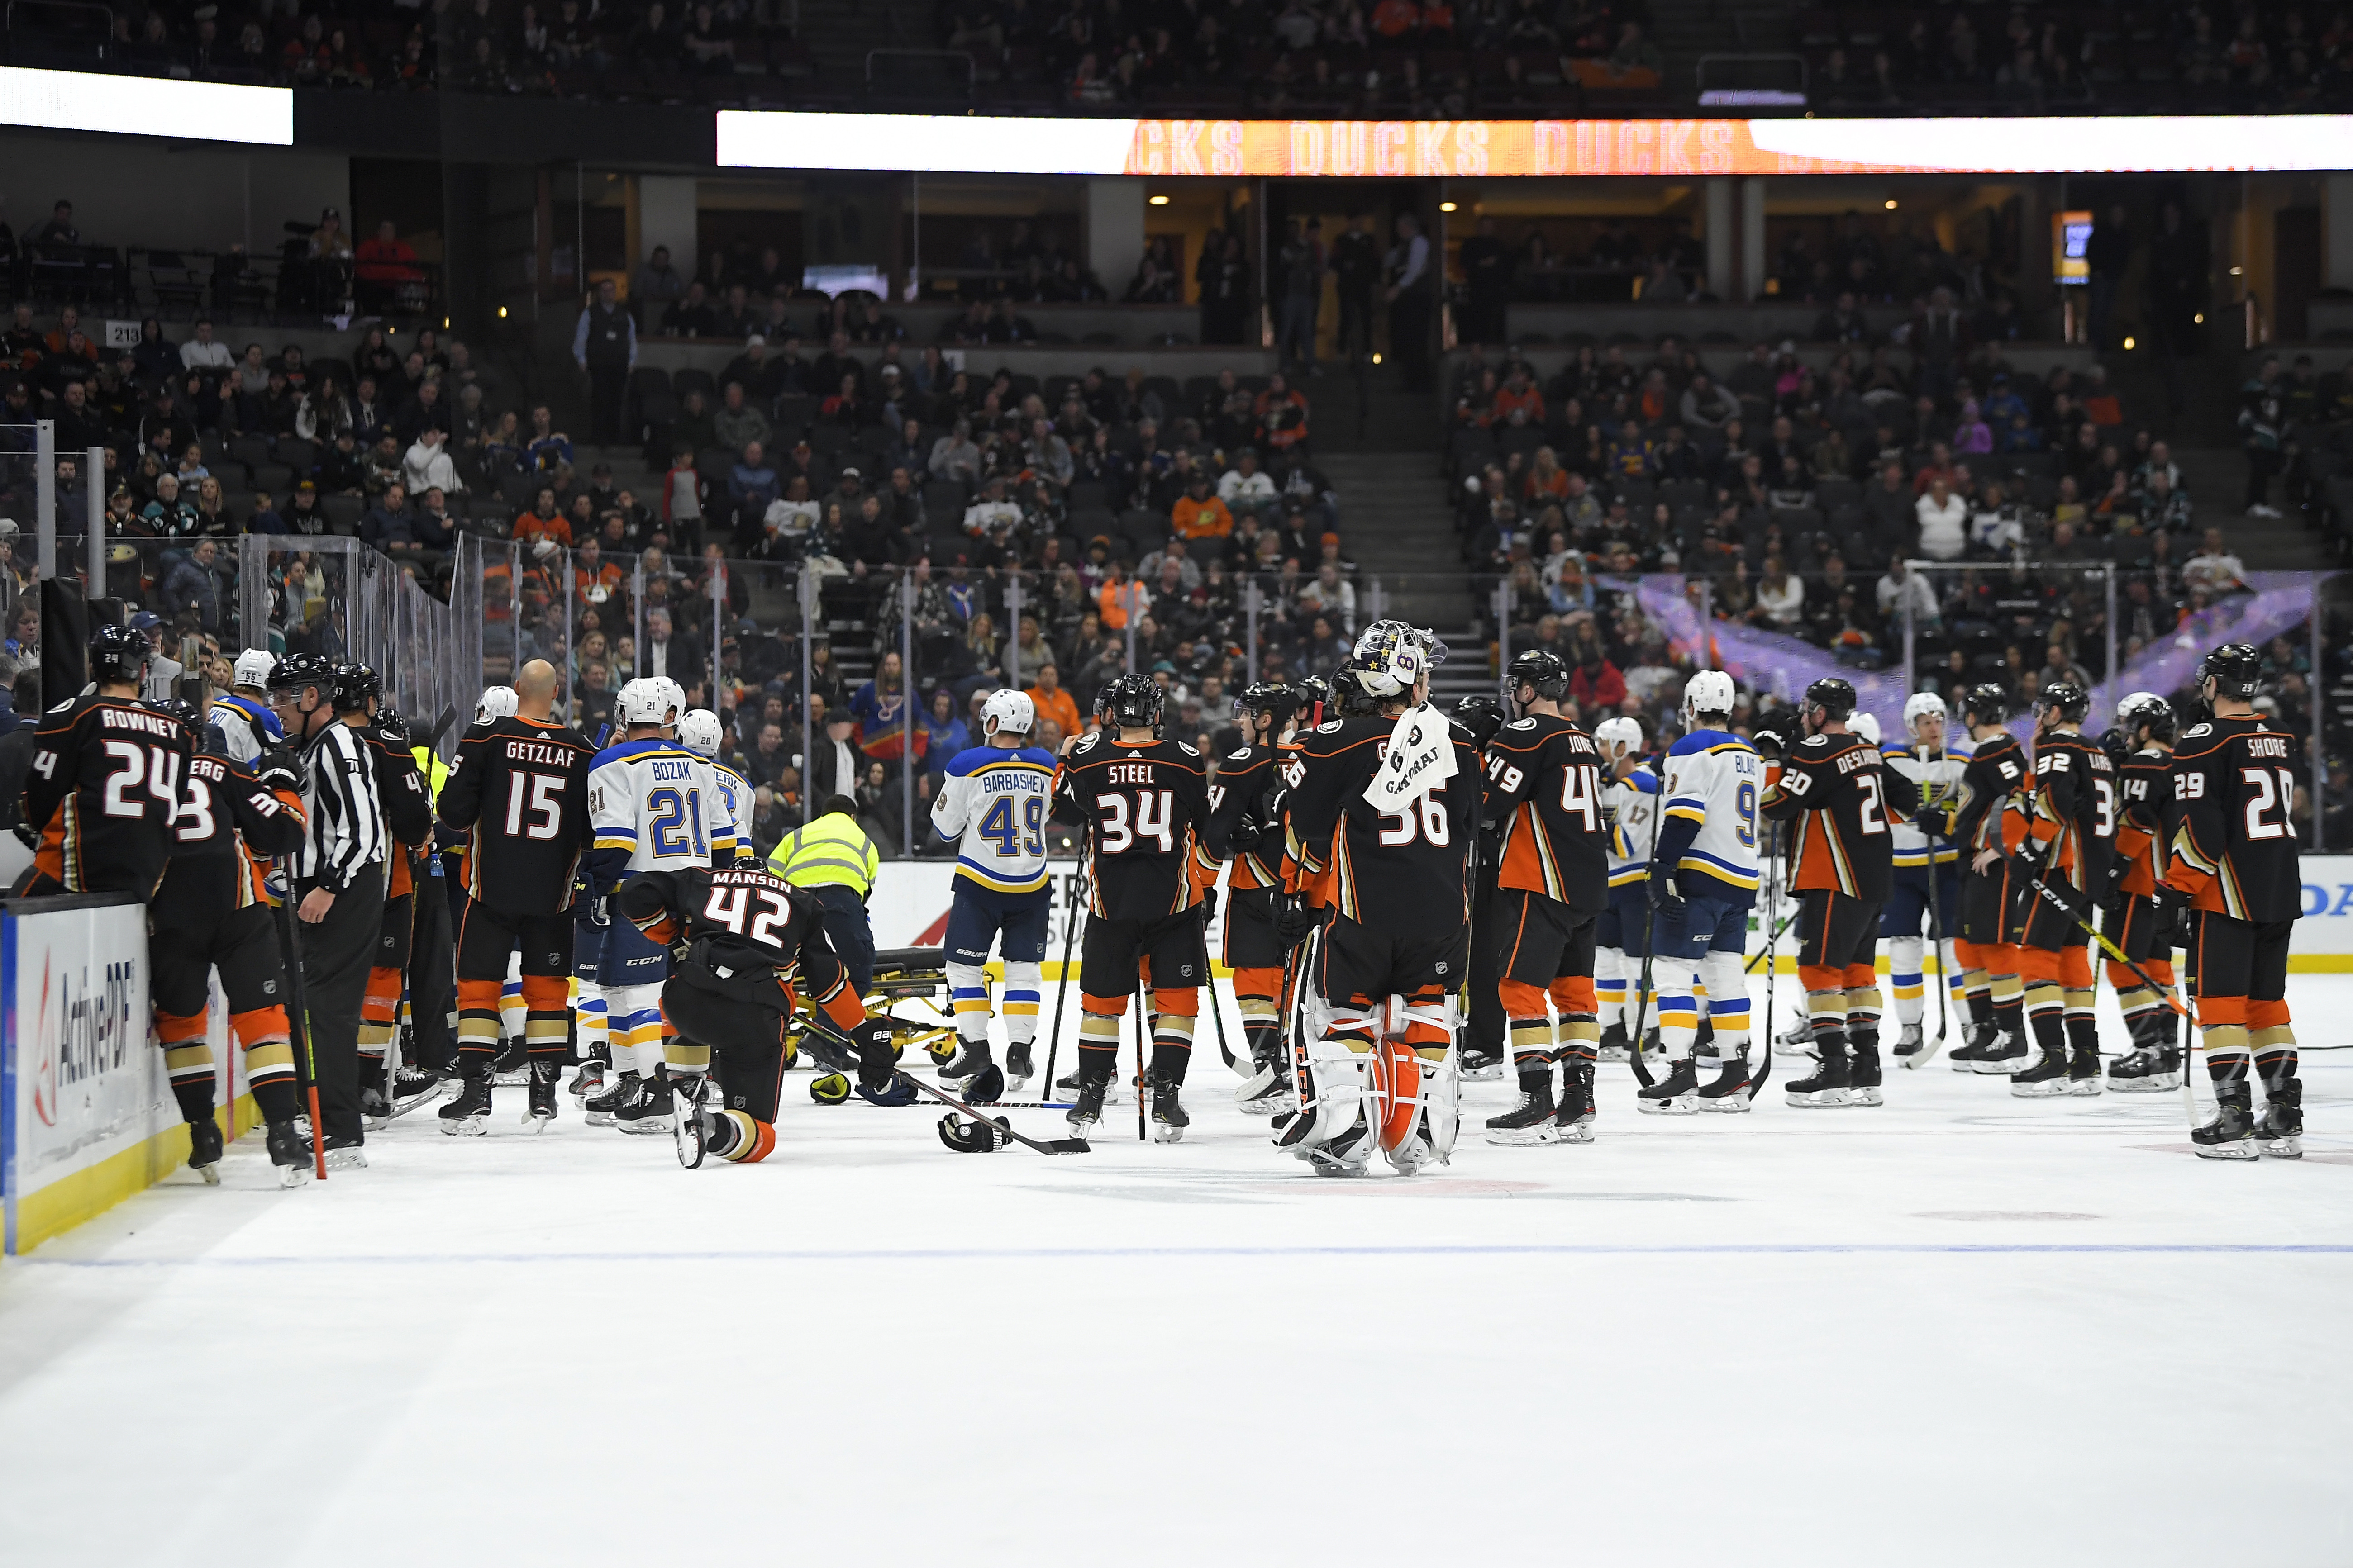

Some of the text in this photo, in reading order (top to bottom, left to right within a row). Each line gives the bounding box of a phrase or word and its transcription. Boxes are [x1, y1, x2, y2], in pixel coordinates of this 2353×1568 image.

[1291, 121, 1489, 175] DUCKS
[1535, 120, 1734, 175] DUCKS
[115, 327, 139, 342] 213
[105, 653, 118, 663] 24
[245, 672, 256, 680] 55
[2242, 683, 2253, 692] 29
[647, 701, 655, 711] 21
[1124, 706, 1135, 716] 34
[101, 708, 178, 740] ROWNEY
[1016, 722, 1028, 730] 49
[700, 737, 711, 745] 28
[2247, 737, 2288, 759] SHORE
[506, 741, 576, 768] GETZLAF
[2036, 752, 2071, 776] 32
[345, 760, 360, 772] 71
[652, 761, 692, 781] BOZAK
[1108, 765, 1155, 785] STEEL
[1488, 755, 1524, 794] 49
[1996, 760, 2020, 780] 5
[100, 739, 180, 828] 24
[982, 773, 1044, 794] BARBASHEV
[1779, 767, 1813, 796] 20
[2123, 779, 2149, 802] 14
[2173, 771, 2205, 801] 29
[504, 769, 567, 841] 15
[589, 786, 605, 816] 21
[647, 787, 709, 859] 21
[977, 795, 1045, 857] 49
[1096, 789, 1173, 854] 34
[712, 872, 792, 894] MANSON
[2031, 878, 2070, 911] CCM
[703, 886, 792, 949] 42
[626, 954, 663, 967] CCM
[956, 948, 988, 958] BAUER
[866, 1000, 887, 1012] CARE
